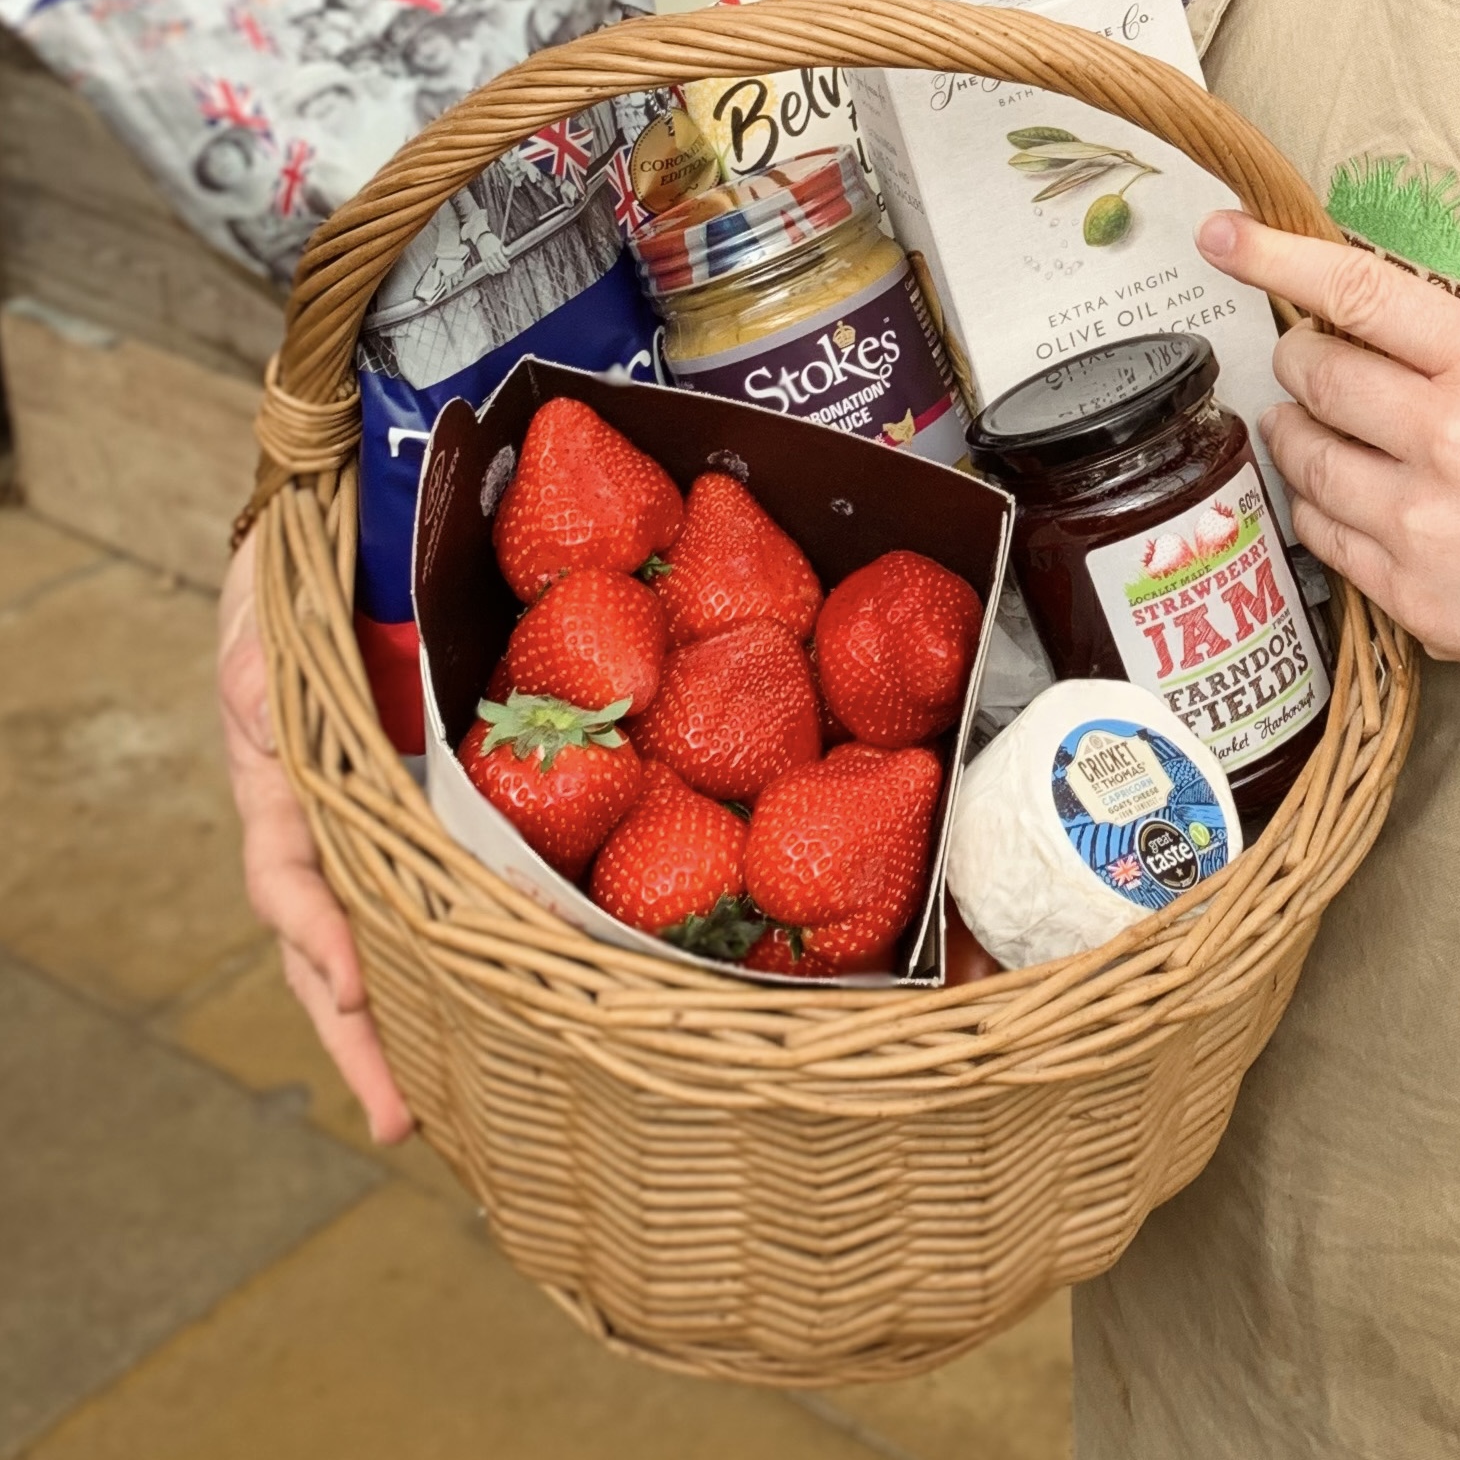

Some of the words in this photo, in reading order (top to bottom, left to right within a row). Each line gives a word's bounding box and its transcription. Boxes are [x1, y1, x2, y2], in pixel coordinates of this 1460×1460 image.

[999, 88, 1034, 107] BATH
[713, 67, 849, 176] Belv
[660, 155, 709, 186] EDITION
[1047, 295, 1109, 328] EXTRA
[1114, 266, 1180, 300] VIRGIN
[1035, 321, 1107, 360] OLIVE
[1117, 302, 1158, 328] OIL
[1166, 285, 1205, 310] AND
[744, 329, 900, 415] Stokes
[828, 407, 873, 433] AUCE
[1239, 487, 1261, 515] 60%
[1244, 504, 1265, 529] FRUIT
[1129, 581, 1177, 608] LOCALLY
[1181, 564, 1213, 586] MADE
[1132, 535, 1268, 626] STRAWBERRY
[1144, 557, 1286, 679] JAM
[1272, 608, 1291, 630] FROM
[1164, 618, 1298, 713] FARNDON
[1178, 641, 1308, 737] FIELDS
[1254, 682, 1316, 740] Harborough
[1077, 741, 1139, 783] CRICKET
[1102, 763, 1146, 790] THOMAS
[1101, 777, 1154, 806] CAPRICORN
[1108, 798, 1131, 815] GOATS
[1132, 787, 1159, 804] CHEESE
[1146, 842, 1194, 875] taste
[1148, 832, 1174, 856] great
